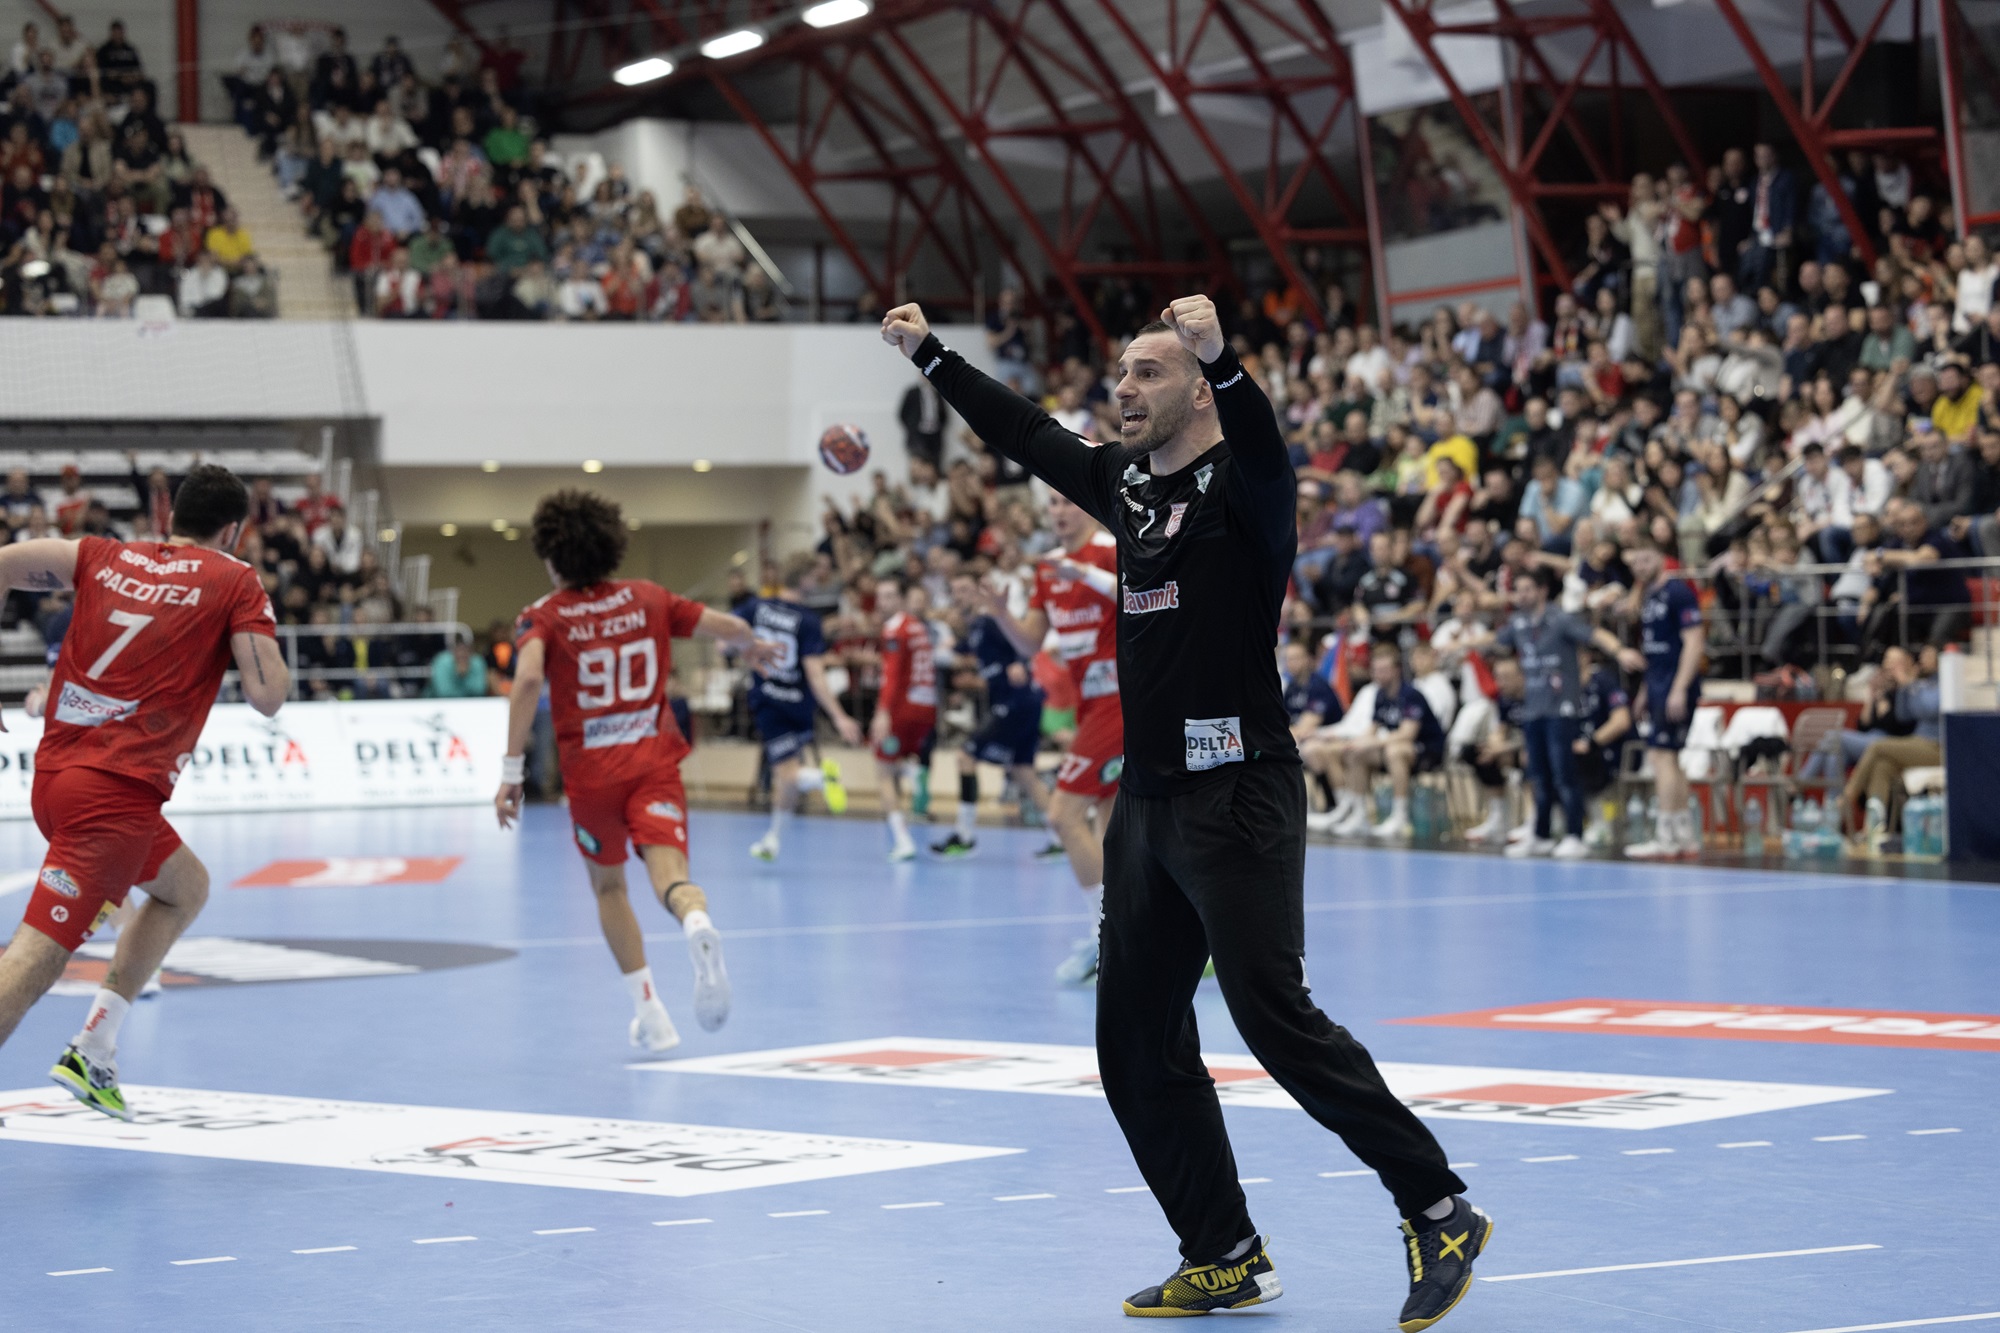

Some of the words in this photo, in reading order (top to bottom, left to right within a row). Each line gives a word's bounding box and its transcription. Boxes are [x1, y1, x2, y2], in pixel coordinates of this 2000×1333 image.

[1215, 369, 1244, 390] Kempa
[1120, 486, 1145, 512] Kempa
[119, 548, 203, 576] SUPERBET
[85, 608, 155, 681] 7
[576, 637, 659, 710] 90
[190, 738, 308, 770] DELTA
[355, 735, 473, 763] DELTA
[1187, 734, 1242, 751] DELTA
[1187, 748, 1243, 760] GLASS
[430, 1135, 796, 1172] DELTA
